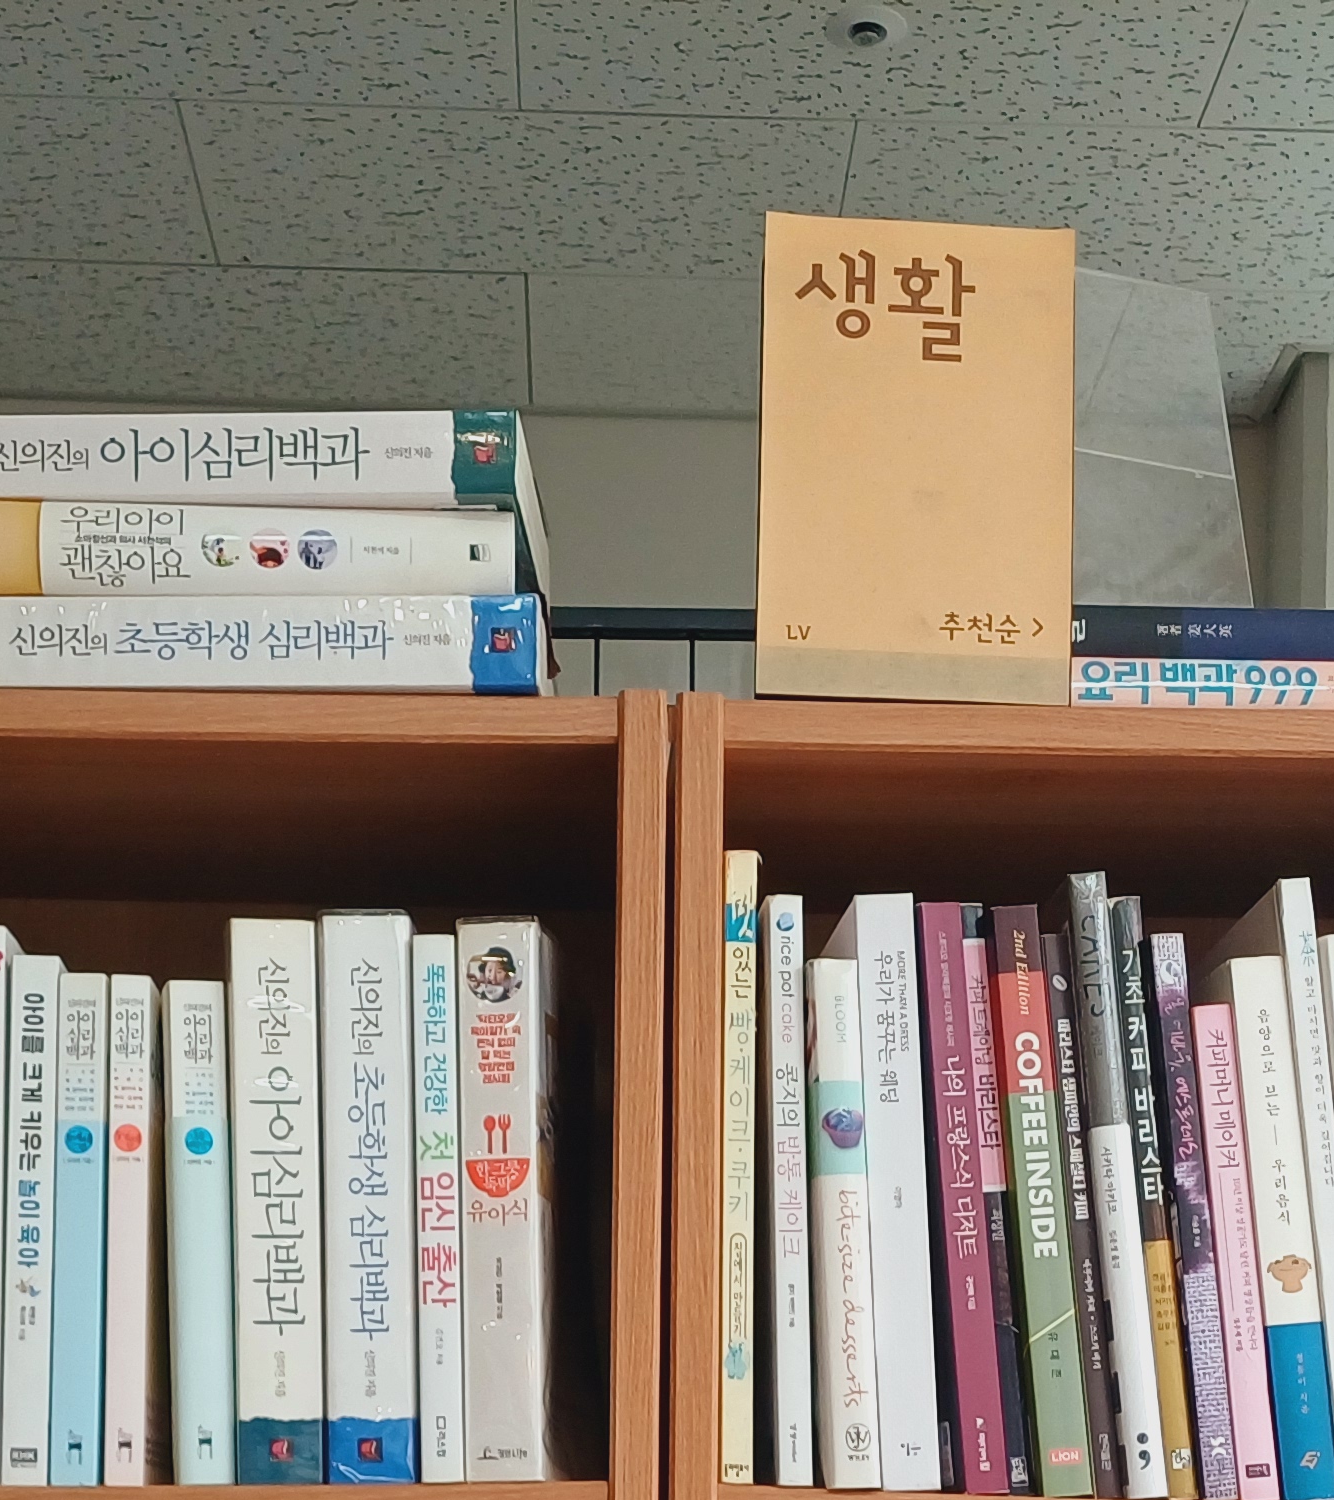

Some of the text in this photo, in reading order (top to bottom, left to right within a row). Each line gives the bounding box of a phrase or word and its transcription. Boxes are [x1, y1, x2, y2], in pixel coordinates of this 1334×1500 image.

[795, 249, 976, 363] 생활
[100, 427, 371, 482] 아이심리백과
[60, 546, 191, 592] 괜찮아요
[786, 625, 811, 642] LV
[939, 611, 1021, 645] 추천순
[9, 618, 394, 662] 신의진의 초등학생 심리백과
[1243, 664, 1318, 708] 999
[873, 950, 900, 1105] 우리가 꿈꾸는 웨딩
[17, 992, 45, 1268] 아이를 크게 키우는 놀이 육아
[348, 957, 390, 1342] 신의진의 초등학생 심리백과
[419, 963, 457, 1308] 똑똑하고 건강한 첫 임신 출산
[776, 1063, 803, 1259] 콩지의 밥통 케이크
[940, 1055, 978, 1259] 나의 프랑스식 디저트
[1013, 1030, 1059, 1260] COFFEE INSIDE
[251, 1064, 307, 1335] 아이심리백과
[467, 1198, 529, 1226] 유아식
